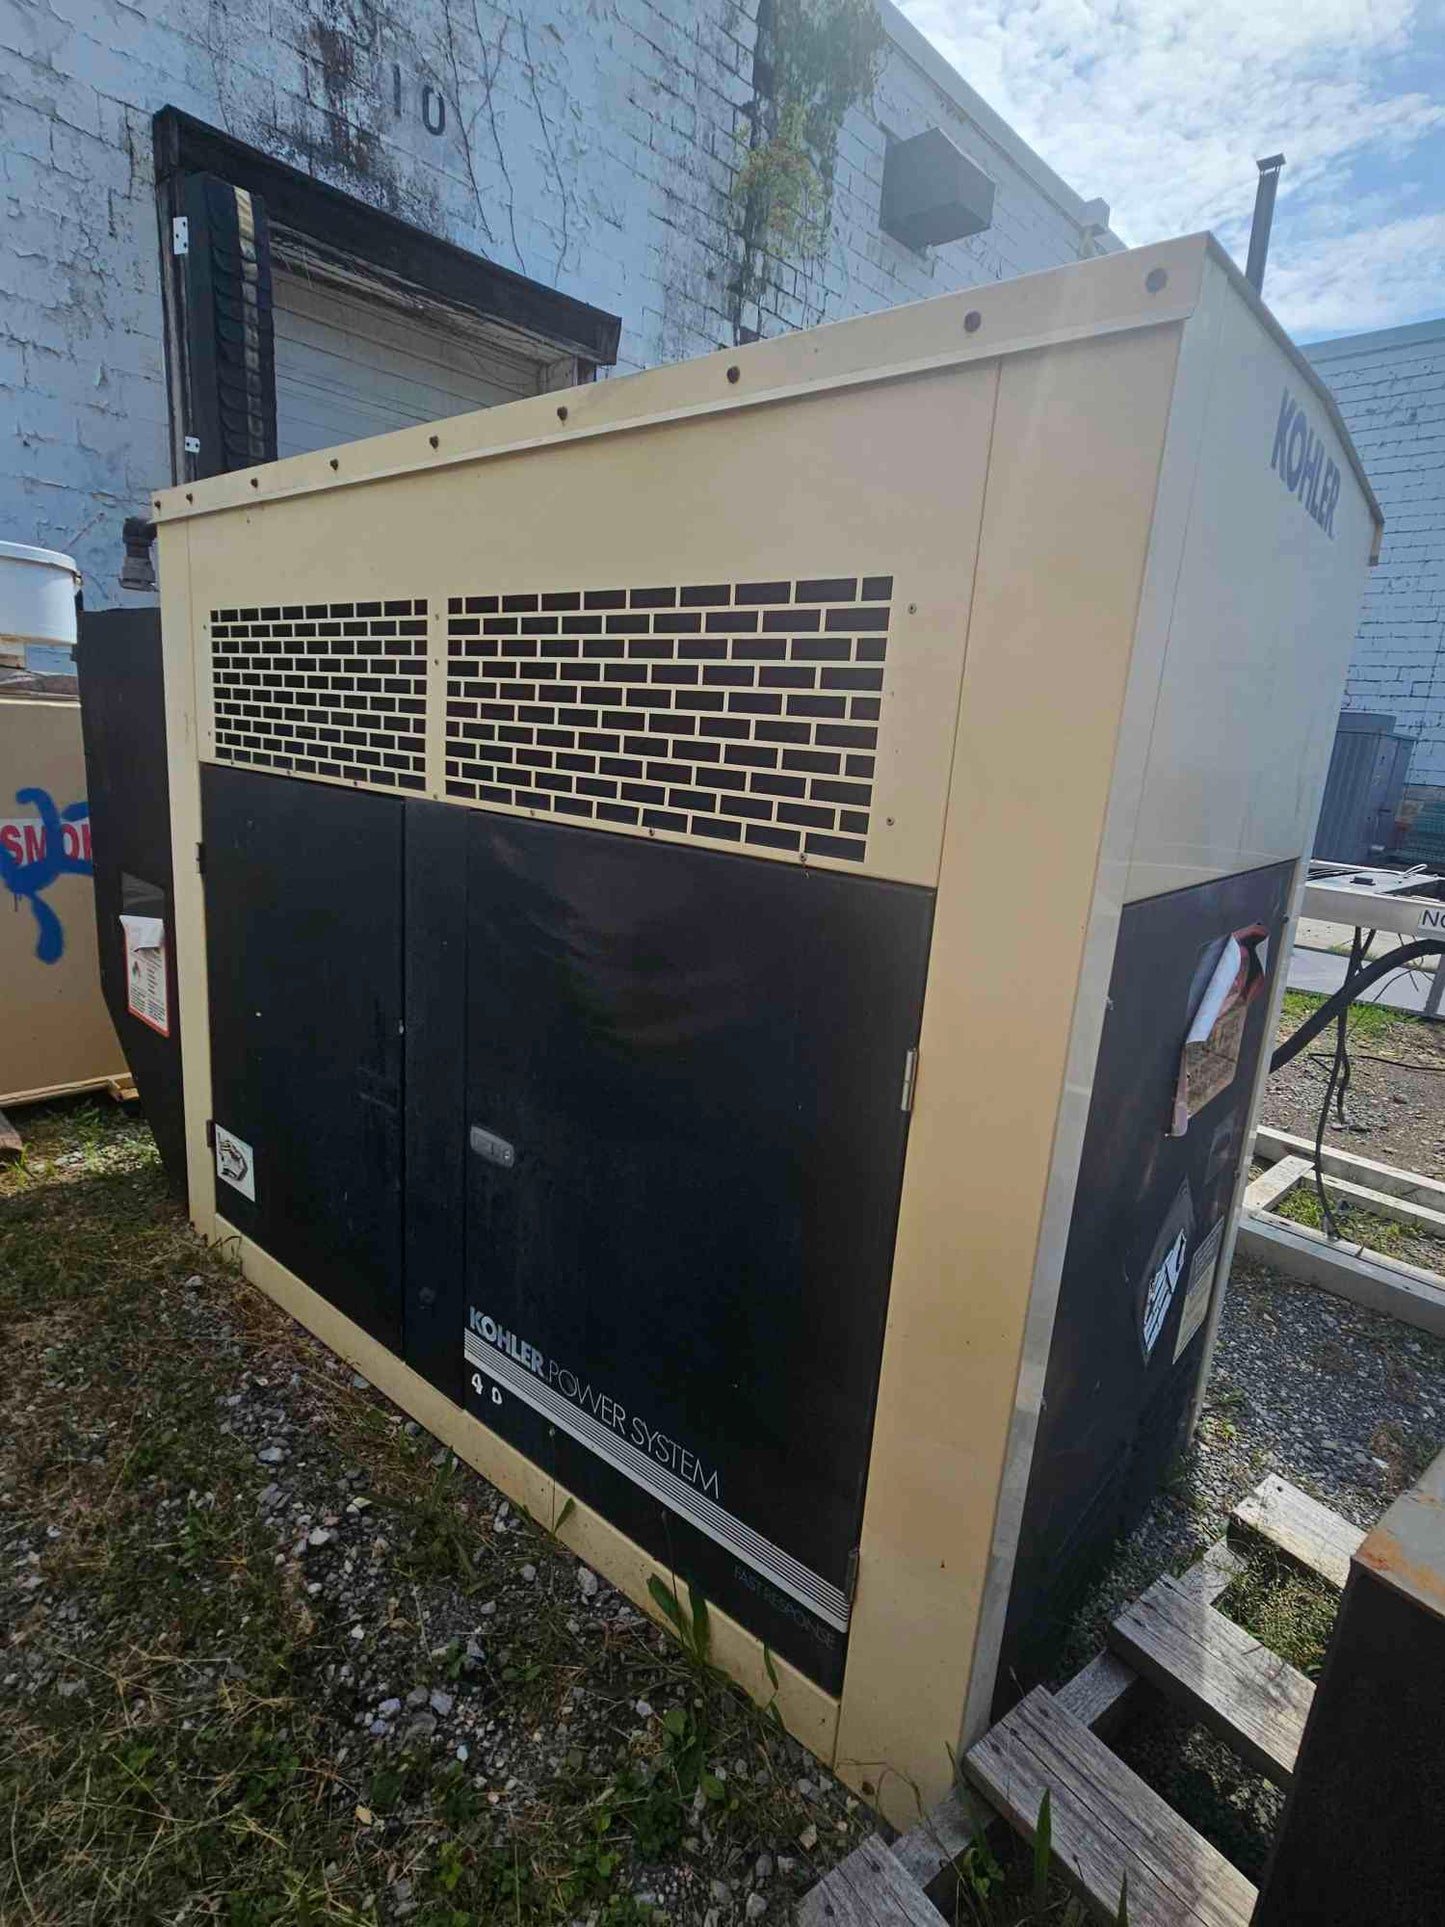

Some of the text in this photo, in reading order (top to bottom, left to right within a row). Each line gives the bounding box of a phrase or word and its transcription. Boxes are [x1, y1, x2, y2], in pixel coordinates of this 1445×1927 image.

[393, 64, 446, 136] 10
[1271, 384, 1341, 541] KOHLER
[469, 1306, 719, 1499] KOHLER POWER SYSTEM
[471, 1373, 503, 1404] 40
